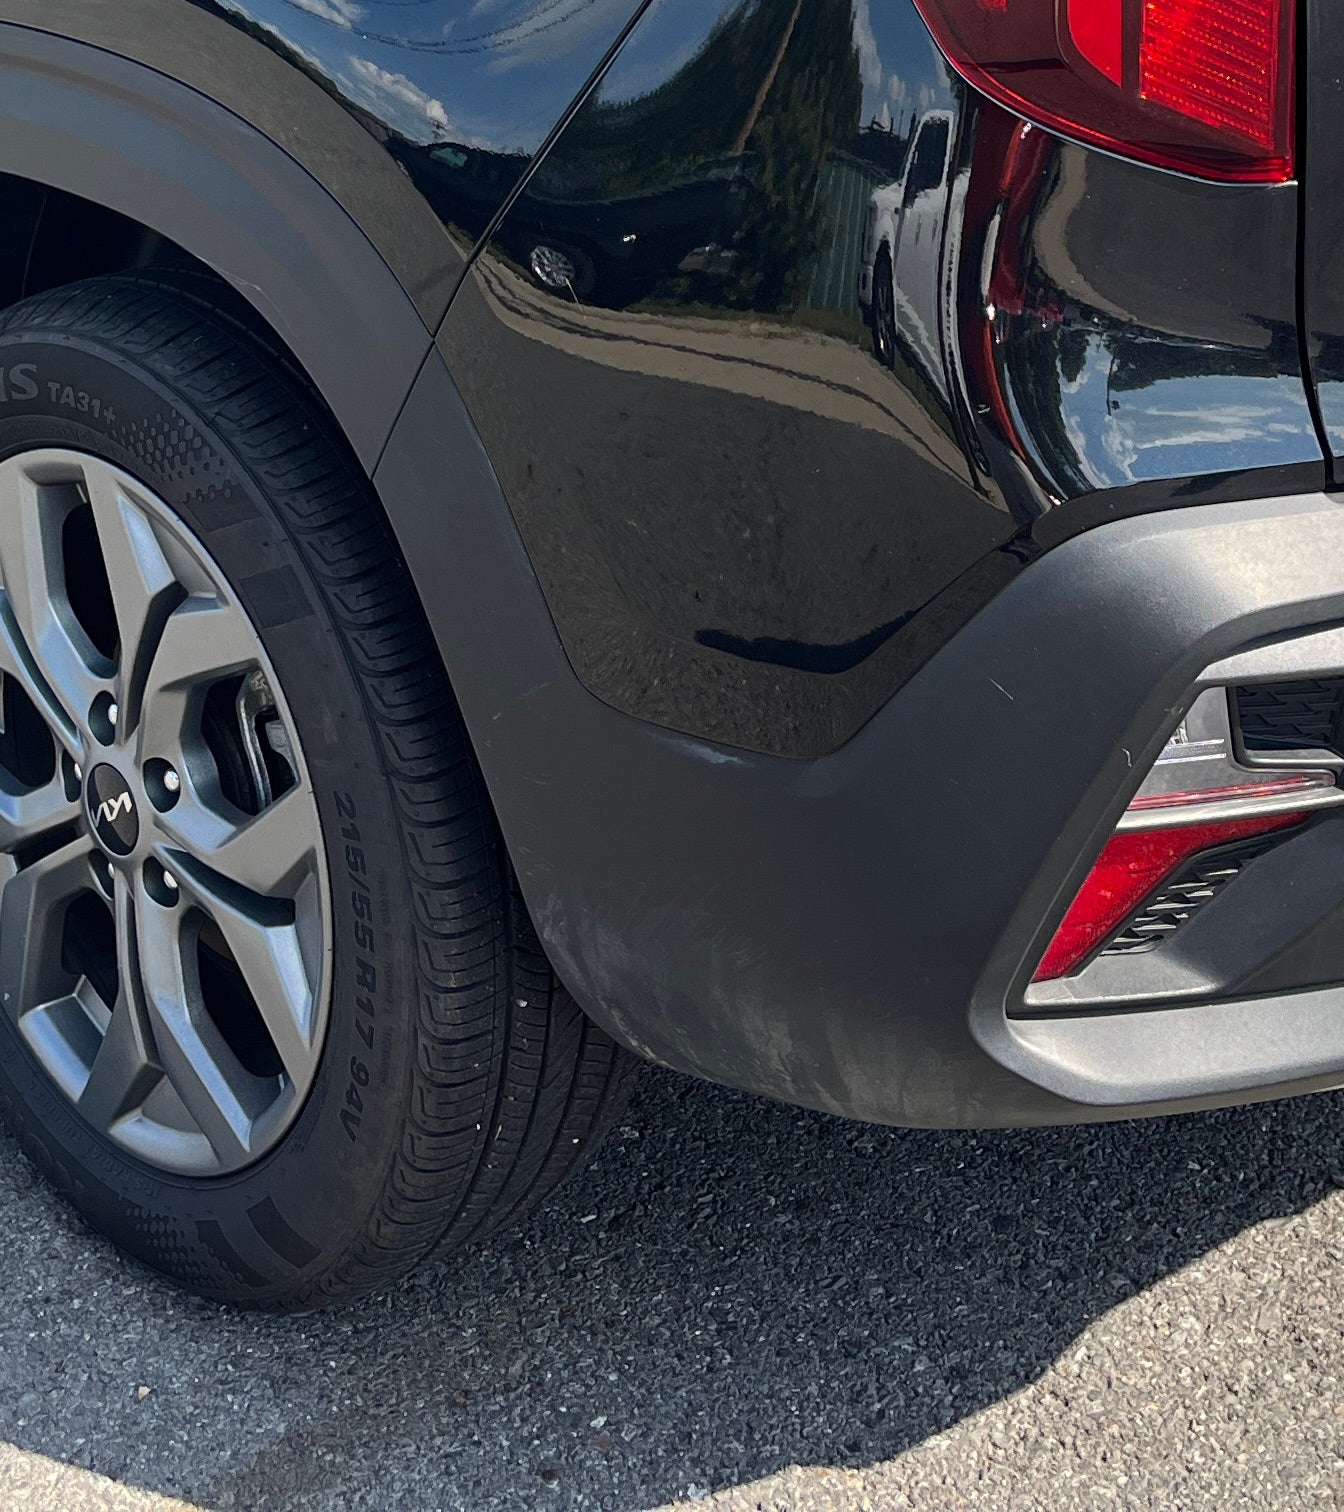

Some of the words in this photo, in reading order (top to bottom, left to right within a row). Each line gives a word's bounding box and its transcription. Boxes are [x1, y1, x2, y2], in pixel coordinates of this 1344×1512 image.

[333, 789, 376, 953] 215/55
[355, 955, 377, 1050] R17
[340, 1055, 370, 1144] 94V
